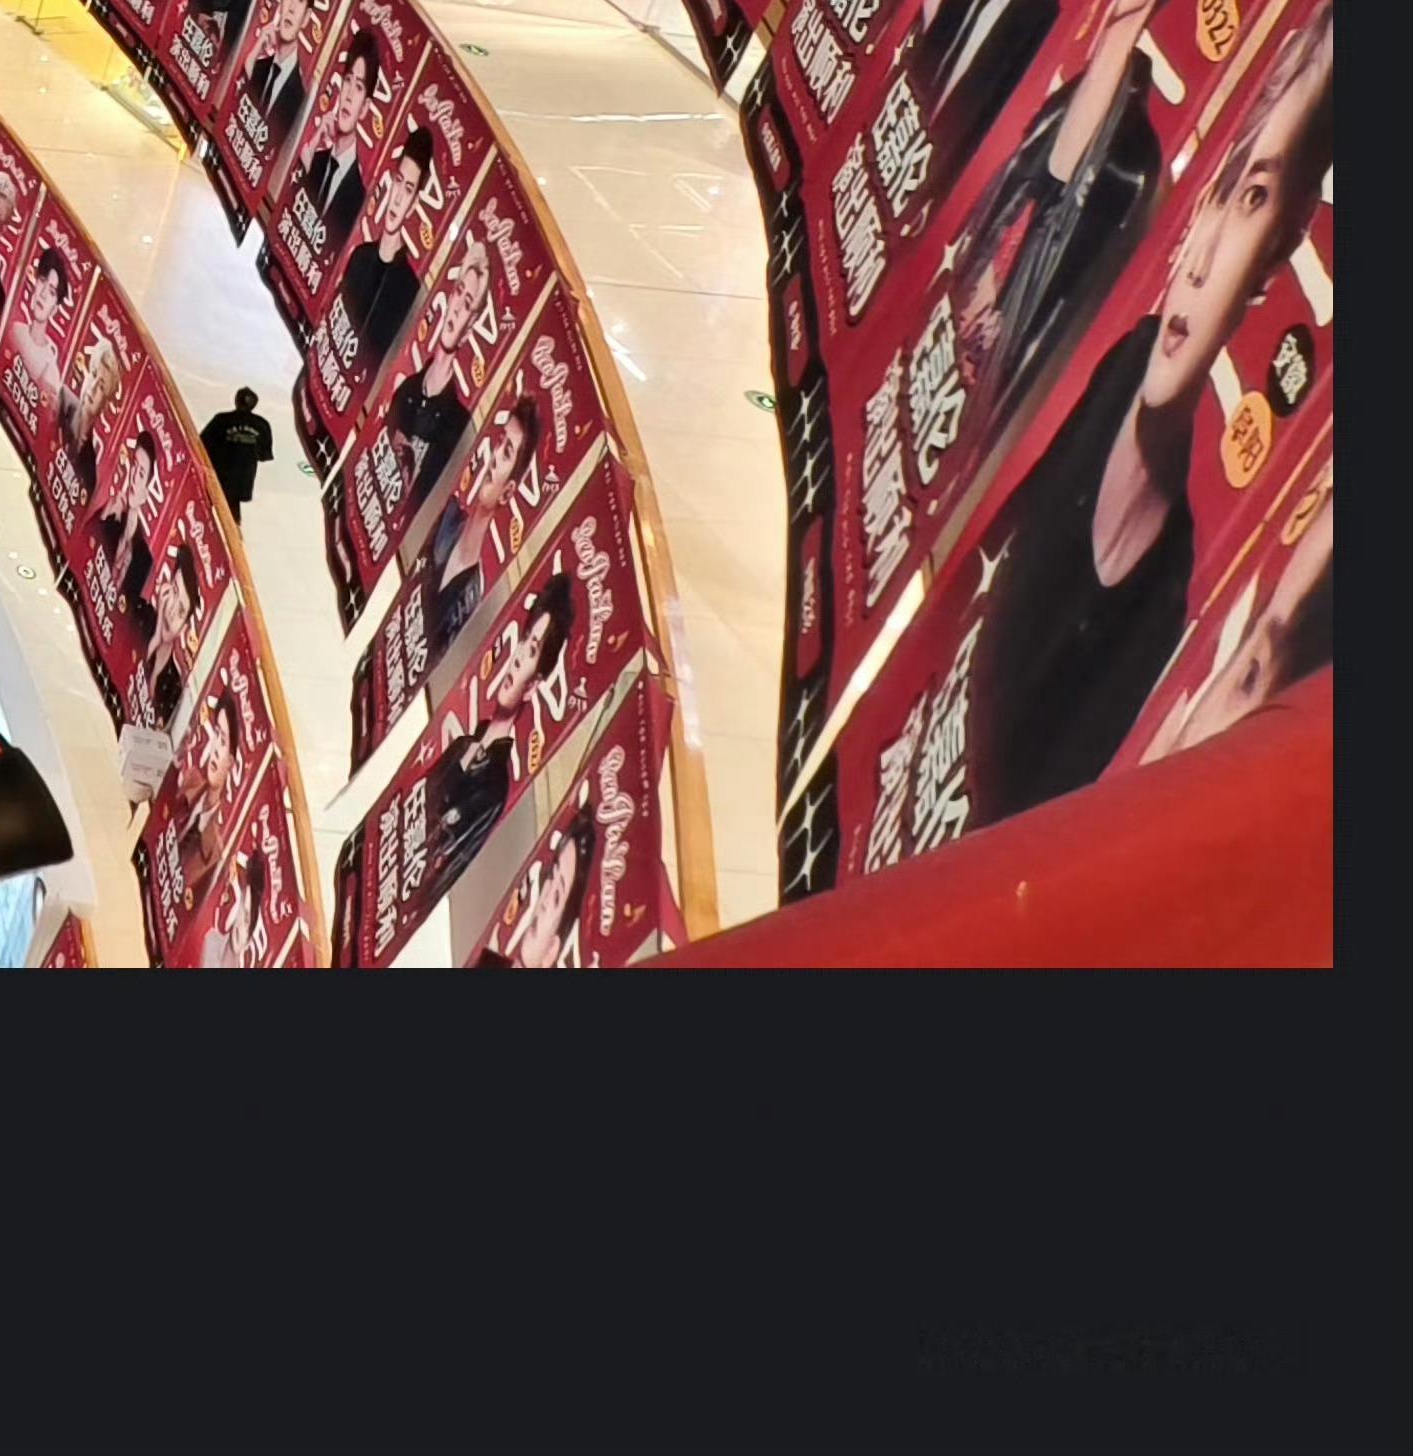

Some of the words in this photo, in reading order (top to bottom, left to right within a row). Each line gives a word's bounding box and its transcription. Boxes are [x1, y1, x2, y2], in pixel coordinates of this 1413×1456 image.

[872, 68, 933, 219] 任嘉伦
[832, 130, 887, 318] 演出顺利
[353, 447, 389, 562] 演出顺利
[371, 424, 405, 515] 任嘉伦
[402, 778, 428, 903] 任嘉伦
